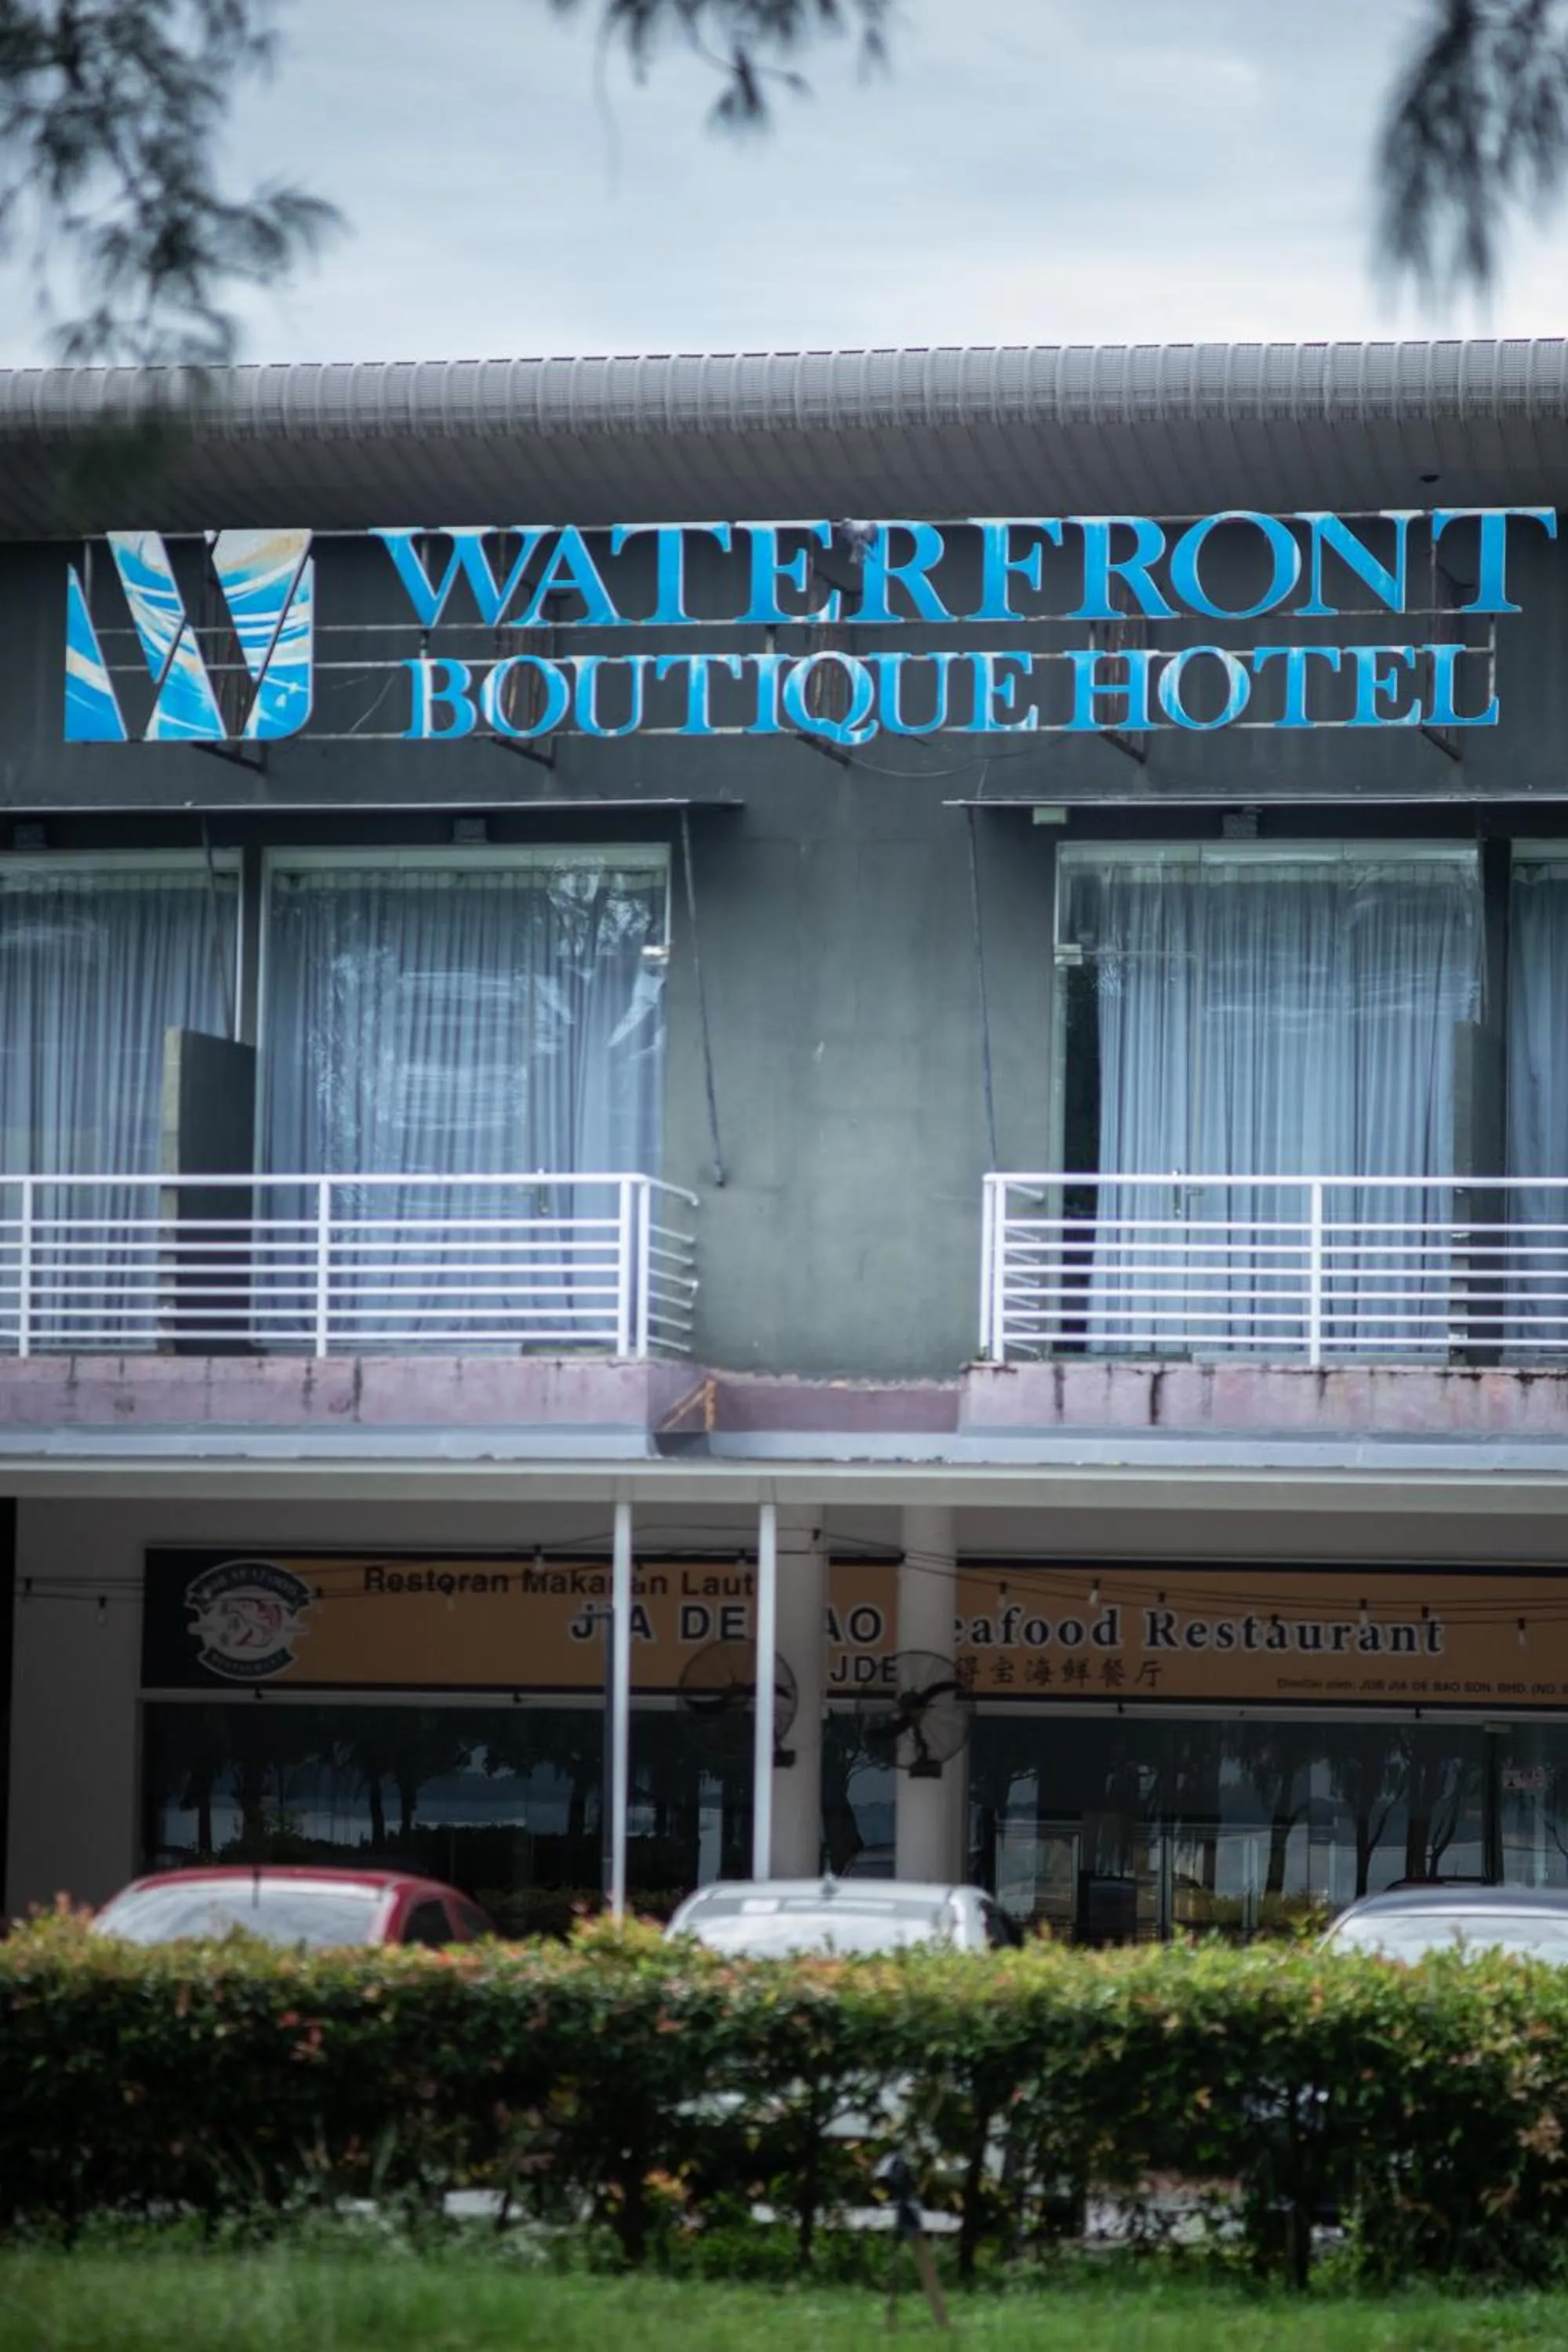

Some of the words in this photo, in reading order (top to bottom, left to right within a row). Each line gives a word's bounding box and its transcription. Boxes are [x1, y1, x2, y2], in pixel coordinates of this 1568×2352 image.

[368, 506, 1557, 628] WATERFRONT
[401, 652, 1038, 746] BOUTIQUE
[1064, 644, 1499, 730] HOTEL
[364, 1567, 509, 1594] Restoran
[522, 1570, 668, 1595] Makaan
[681, 1572, 754, 1596] Laut
[572, 1602, 652, 1640] JA
[680, 1605, 746, 1640] DE
[1148, 1612, 1441, 1653] Restaurant
